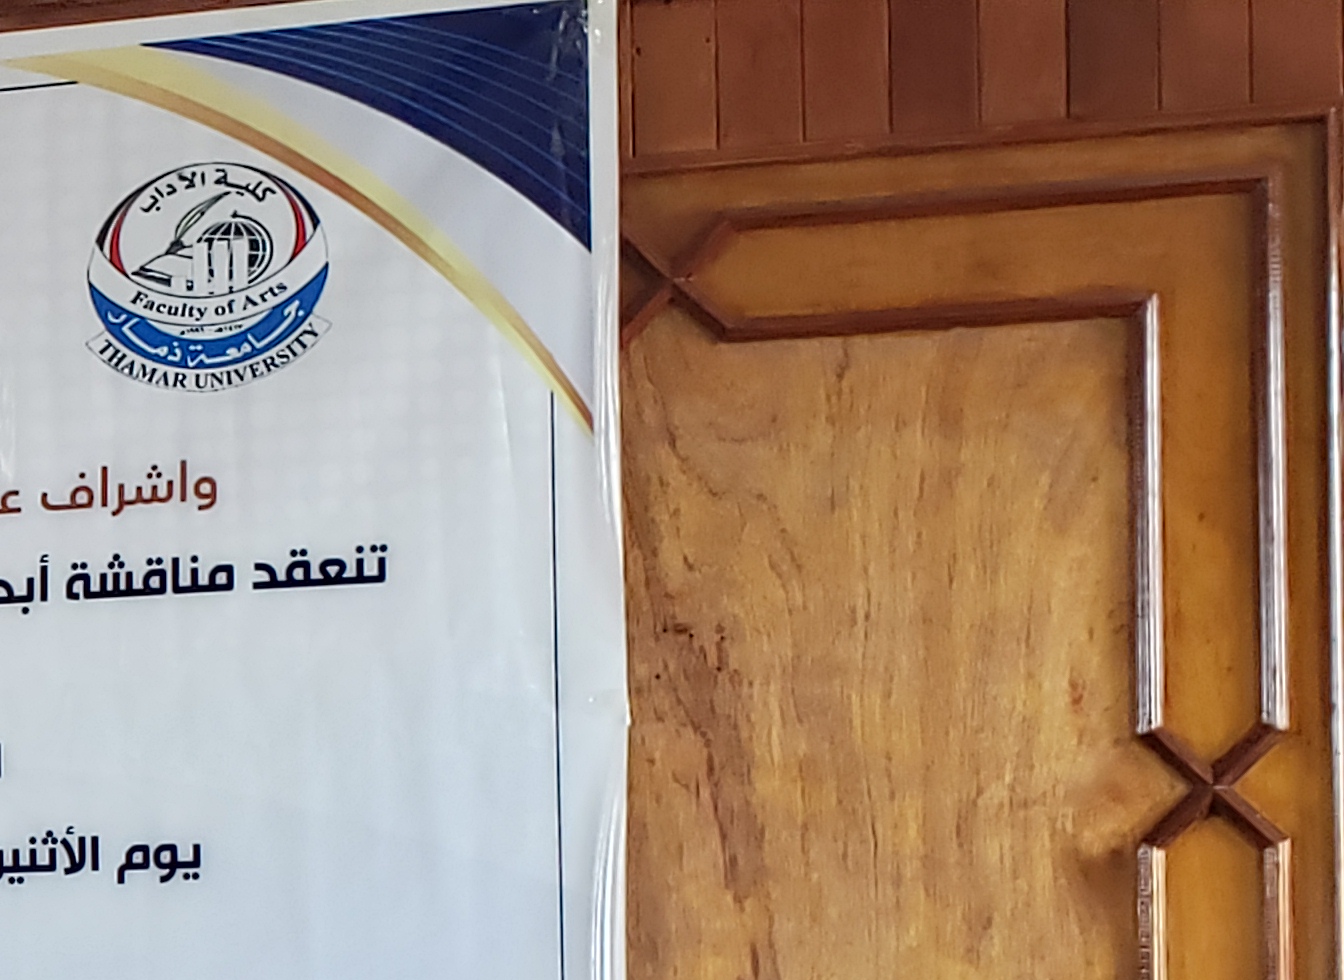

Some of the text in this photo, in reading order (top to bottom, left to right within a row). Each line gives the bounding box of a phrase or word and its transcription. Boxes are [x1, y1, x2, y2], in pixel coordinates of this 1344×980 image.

[214, 168, 278, 203] كلية
[130, 281, 289, 322] Faculty of Arts
[98, 322, 320, 389] THAMAR UNIVERSITY
[107, 299, 305, 368] جامعة ذمار
[40, 459, 218, 517] واشراف
[65, 552, 235, 601] مناقشة
[251, 543, 389, 591] تنعقد
[116, 843, 202, 885] يوم
